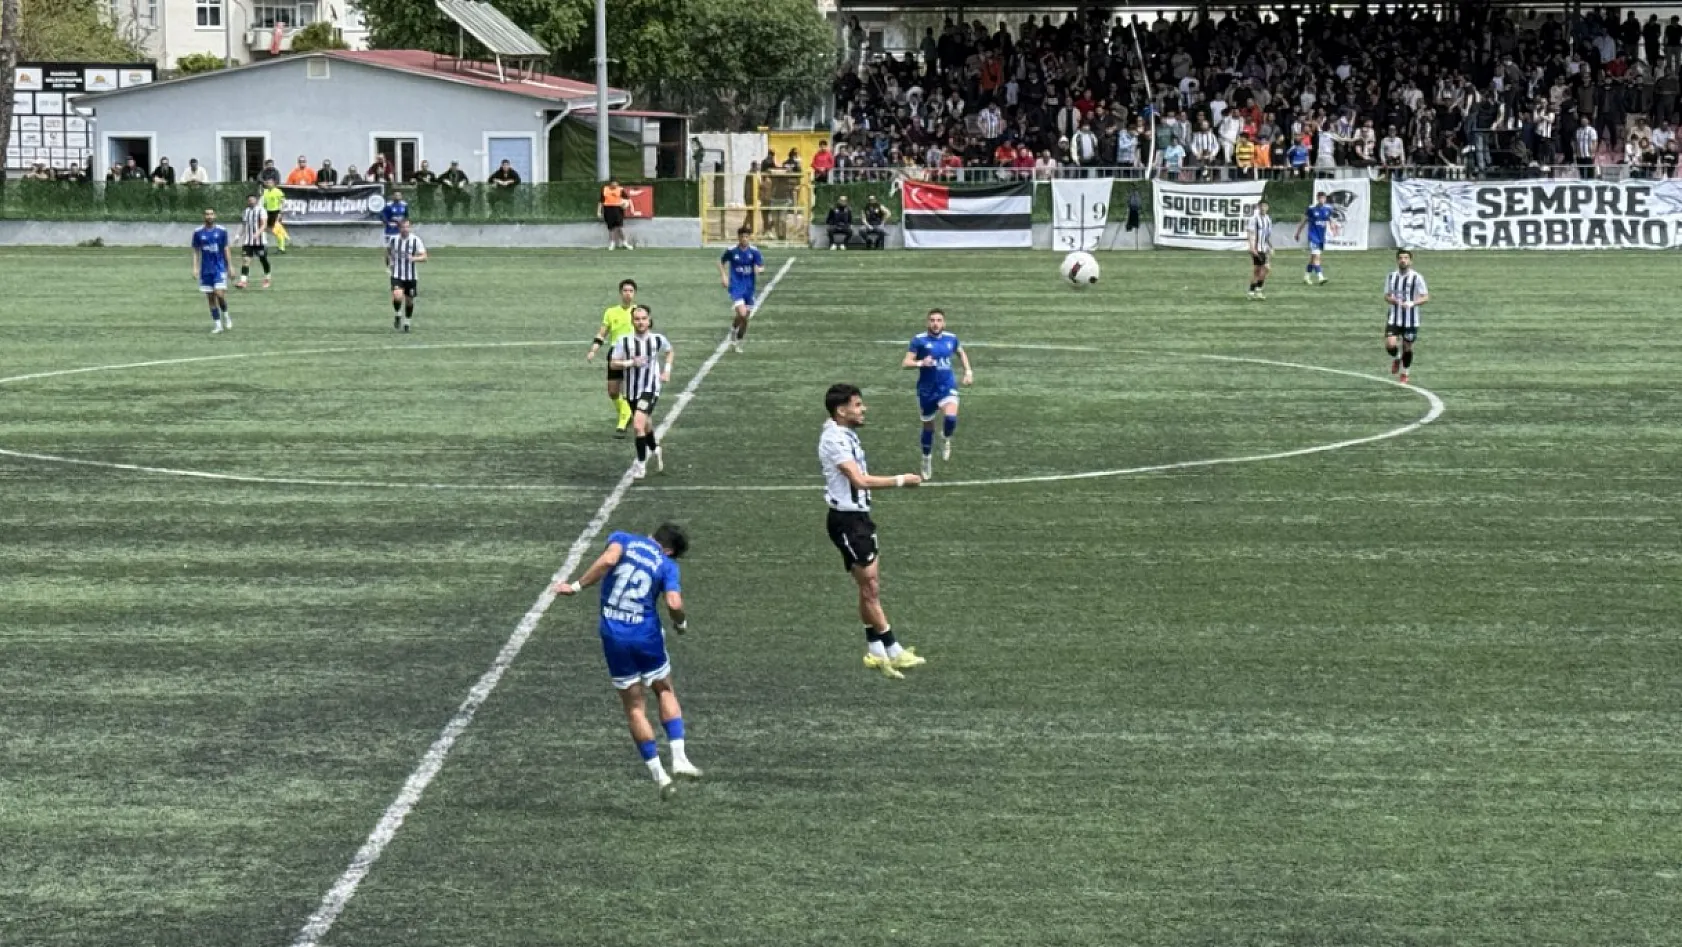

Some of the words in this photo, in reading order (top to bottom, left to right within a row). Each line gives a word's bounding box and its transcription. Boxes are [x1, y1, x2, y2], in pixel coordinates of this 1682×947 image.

[1092, 202, 1106, 220] 9
[1162, 195, 1241, 217] SOLDIERS
[1476, 185, 1651, 218] SEMPRE
[1162, 215, 1246, 236] MARMAR
[1462, 218, 1669, 247] GABBIANO
[608, 562, 653, 614] 12
